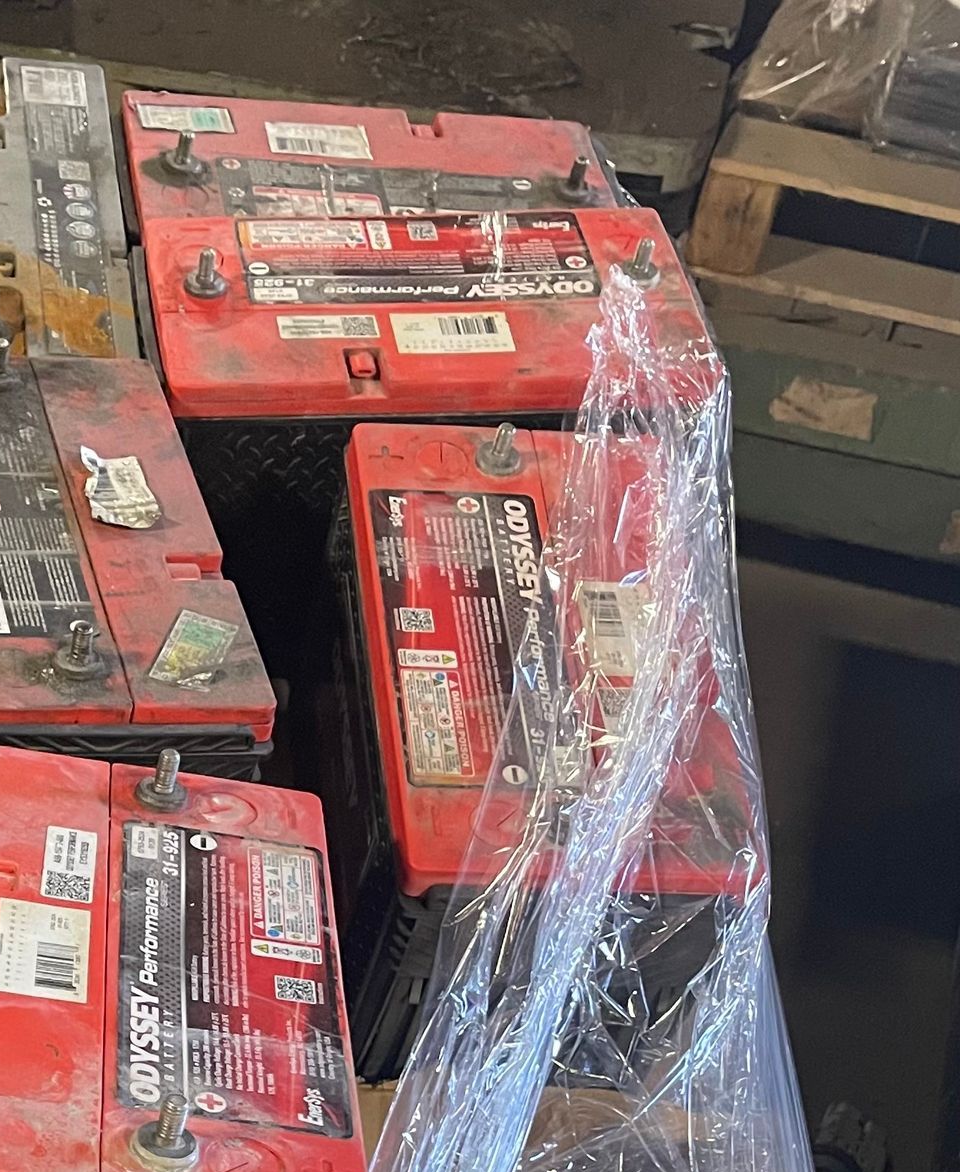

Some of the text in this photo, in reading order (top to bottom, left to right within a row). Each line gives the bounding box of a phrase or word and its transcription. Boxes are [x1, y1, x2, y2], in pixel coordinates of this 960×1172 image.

[254, 277, 594, 298] ODYSSEY Performance 31-925
[496, 518, 514, 586] BATTERY
[503, 499, 542, 603] ODYSSEY
[163, 830, 180, 876] 31-925
[139, 878, 159, 986] Performance
[130, 985, 161, 1103] ODYSSEY
[164, 1009, 175, 1082] BATTERY
[297, 1087, 325, 1126] EnerSys
